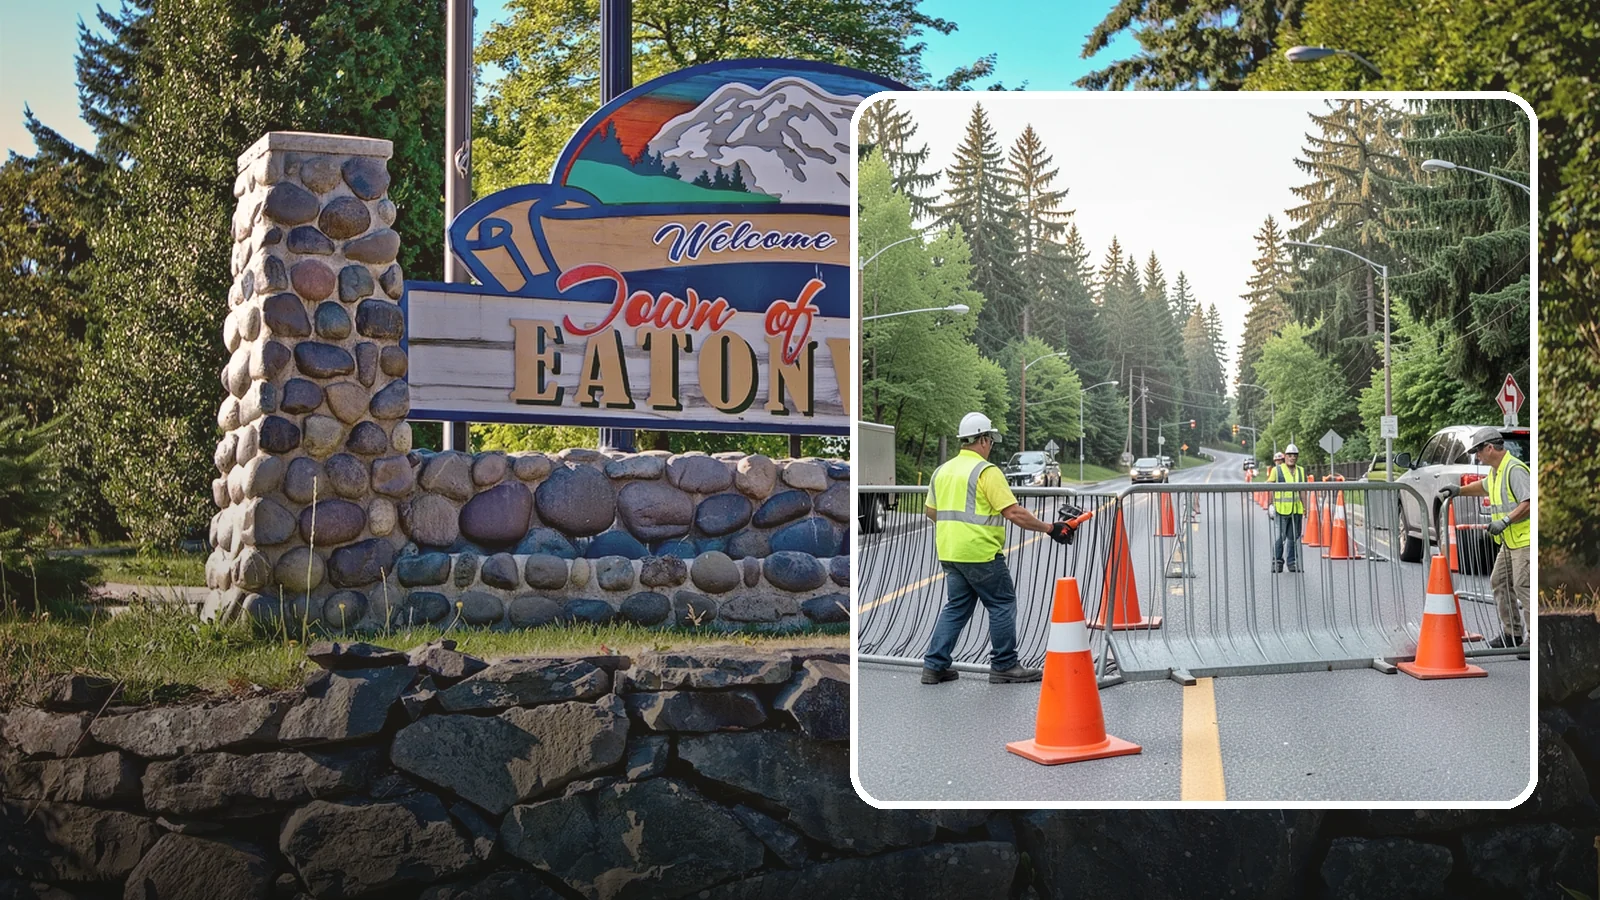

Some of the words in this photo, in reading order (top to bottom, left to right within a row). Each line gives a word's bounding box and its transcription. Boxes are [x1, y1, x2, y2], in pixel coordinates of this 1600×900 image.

[653, 220, 838, 263] Welcome
[557, 263, 737, 337] Town
[765, 279, 826, 366] of
